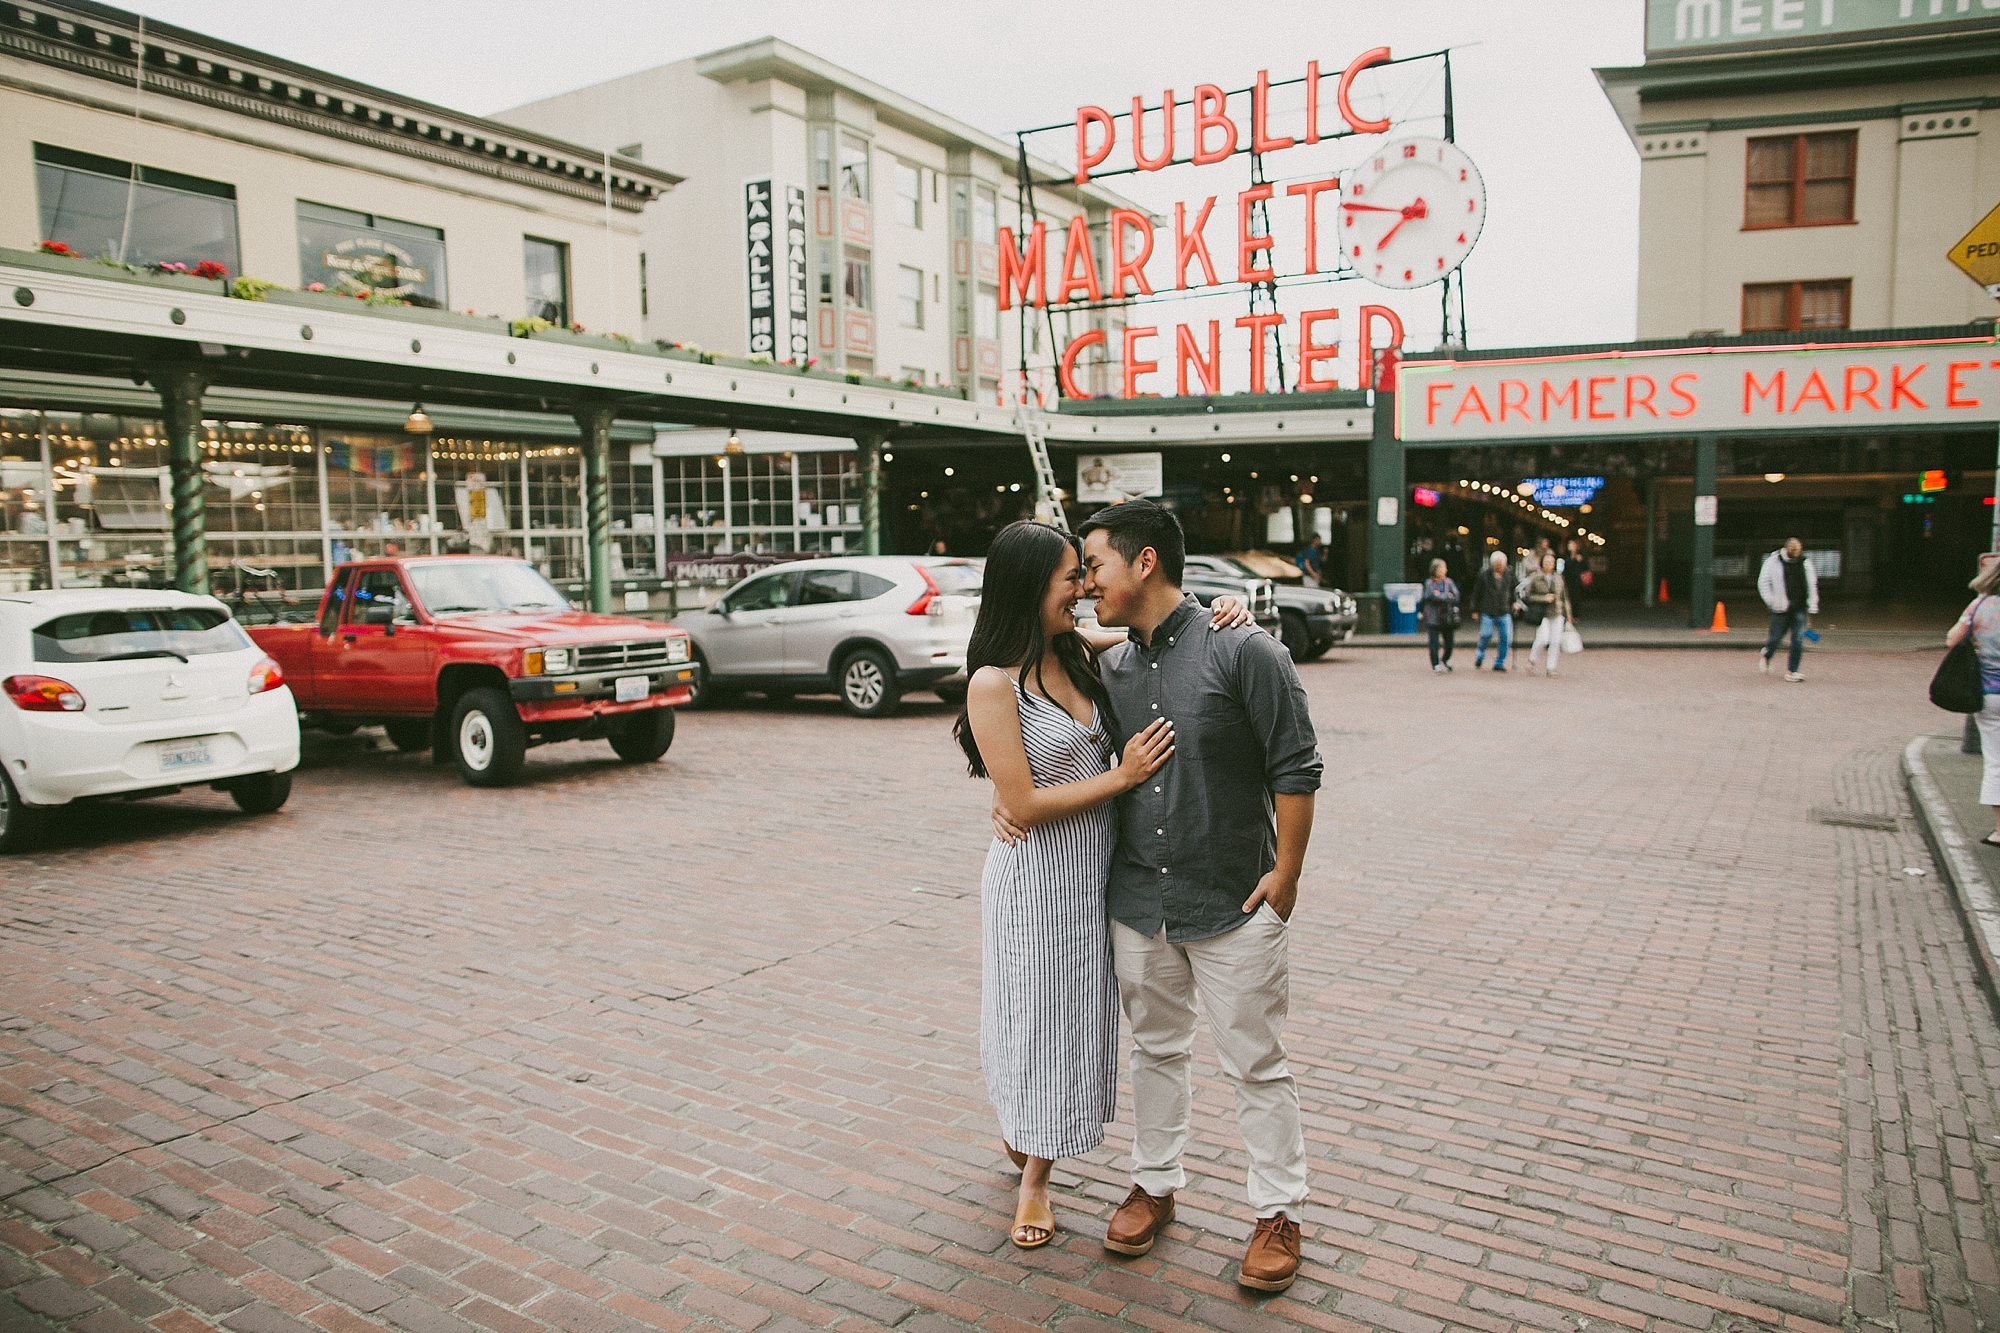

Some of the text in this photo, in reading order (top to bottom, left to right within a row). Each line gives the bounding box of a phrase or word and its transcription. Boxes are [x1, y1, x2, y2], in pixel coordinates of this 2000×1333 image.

[1075, 47, 1391, 185] PUBLIC
[999, 178, 1341, 311] MARKET
[1059, 305, 1405, 400] CENTER
[1426, 360, 2000, 426] FARMERS MARKE
